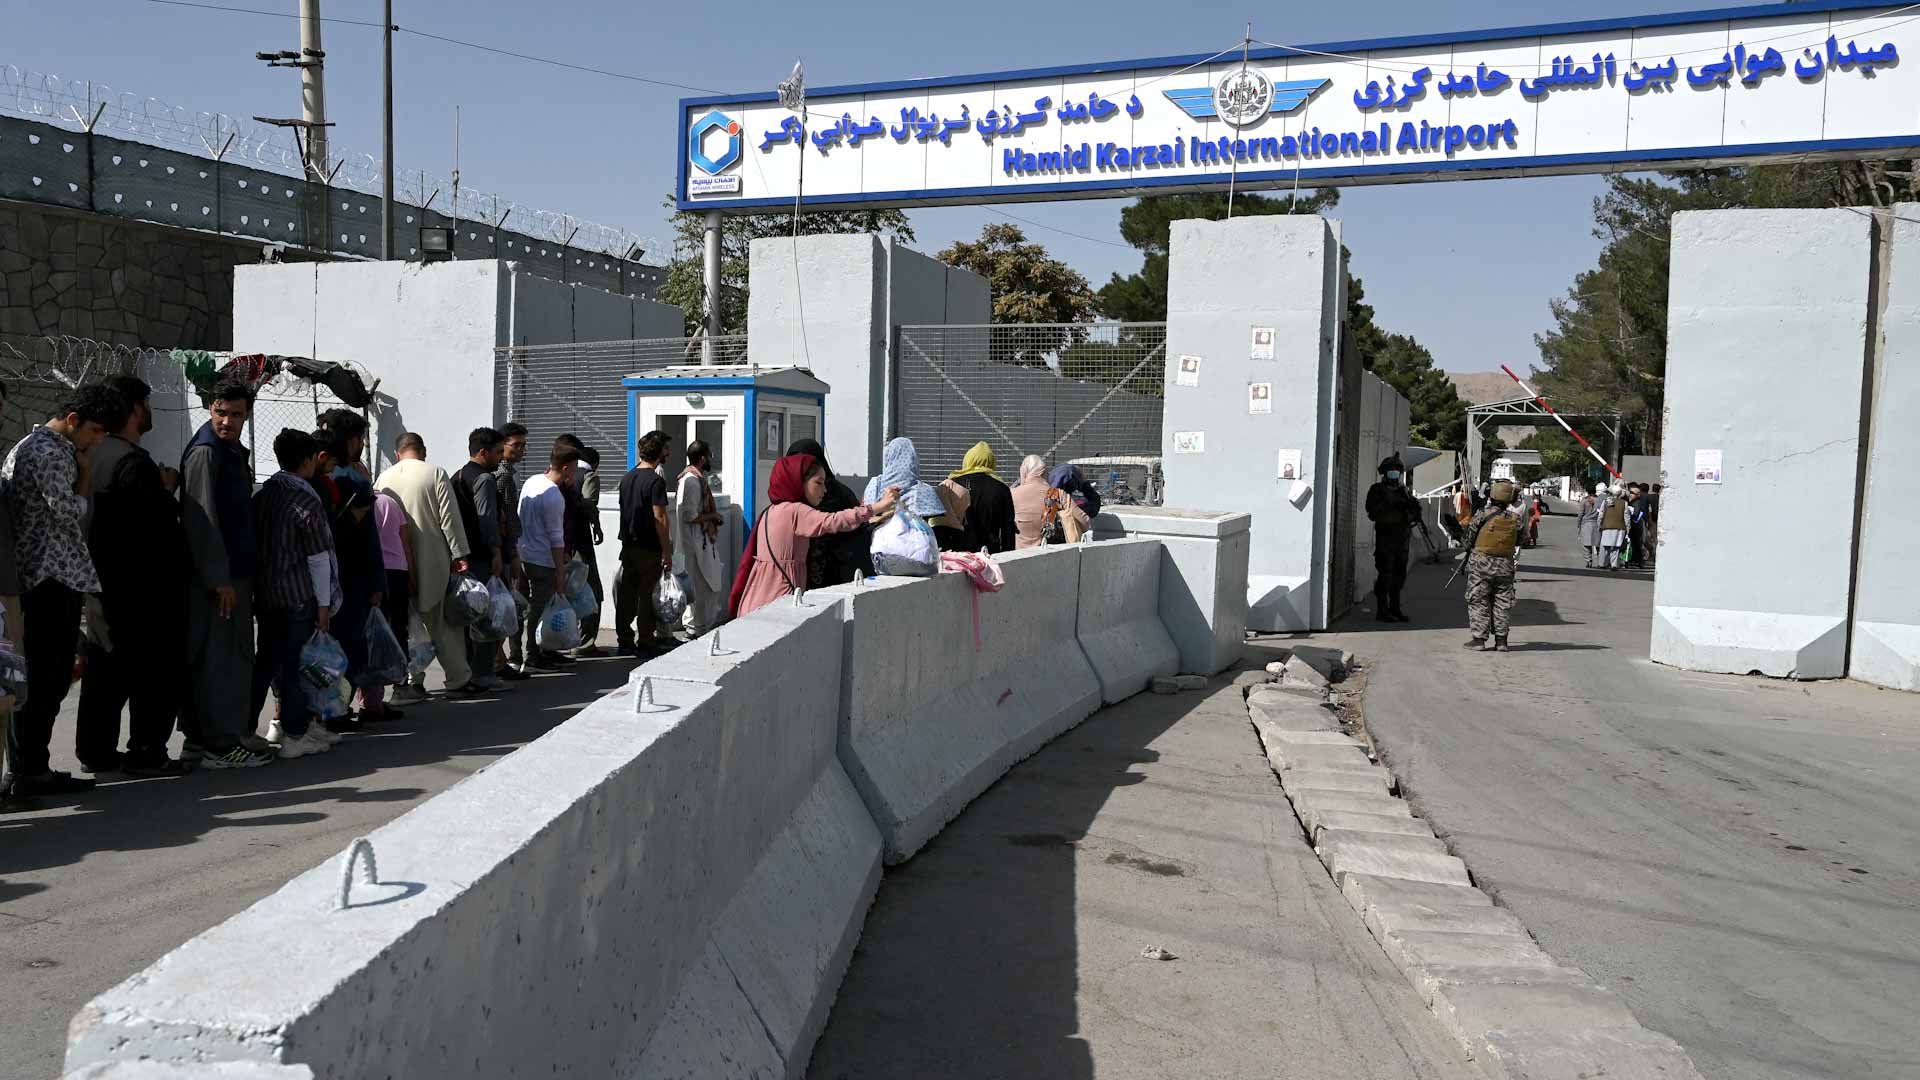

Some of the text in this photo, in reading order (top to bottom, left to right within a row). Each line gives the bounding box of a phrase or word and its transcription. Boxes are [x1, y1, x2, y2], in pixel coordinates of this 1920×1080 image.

[1623, 57, 1677, 91] بین
[1687, 43, 1784, 84] هوایی
[1794, 34, 1897, 80] میدان
[1438, 63, 1510, 94] حامد
[1057, 91, 1118, 121] حامد
[1003, 118, 1516, 173] Hamid Karzai International Airport
